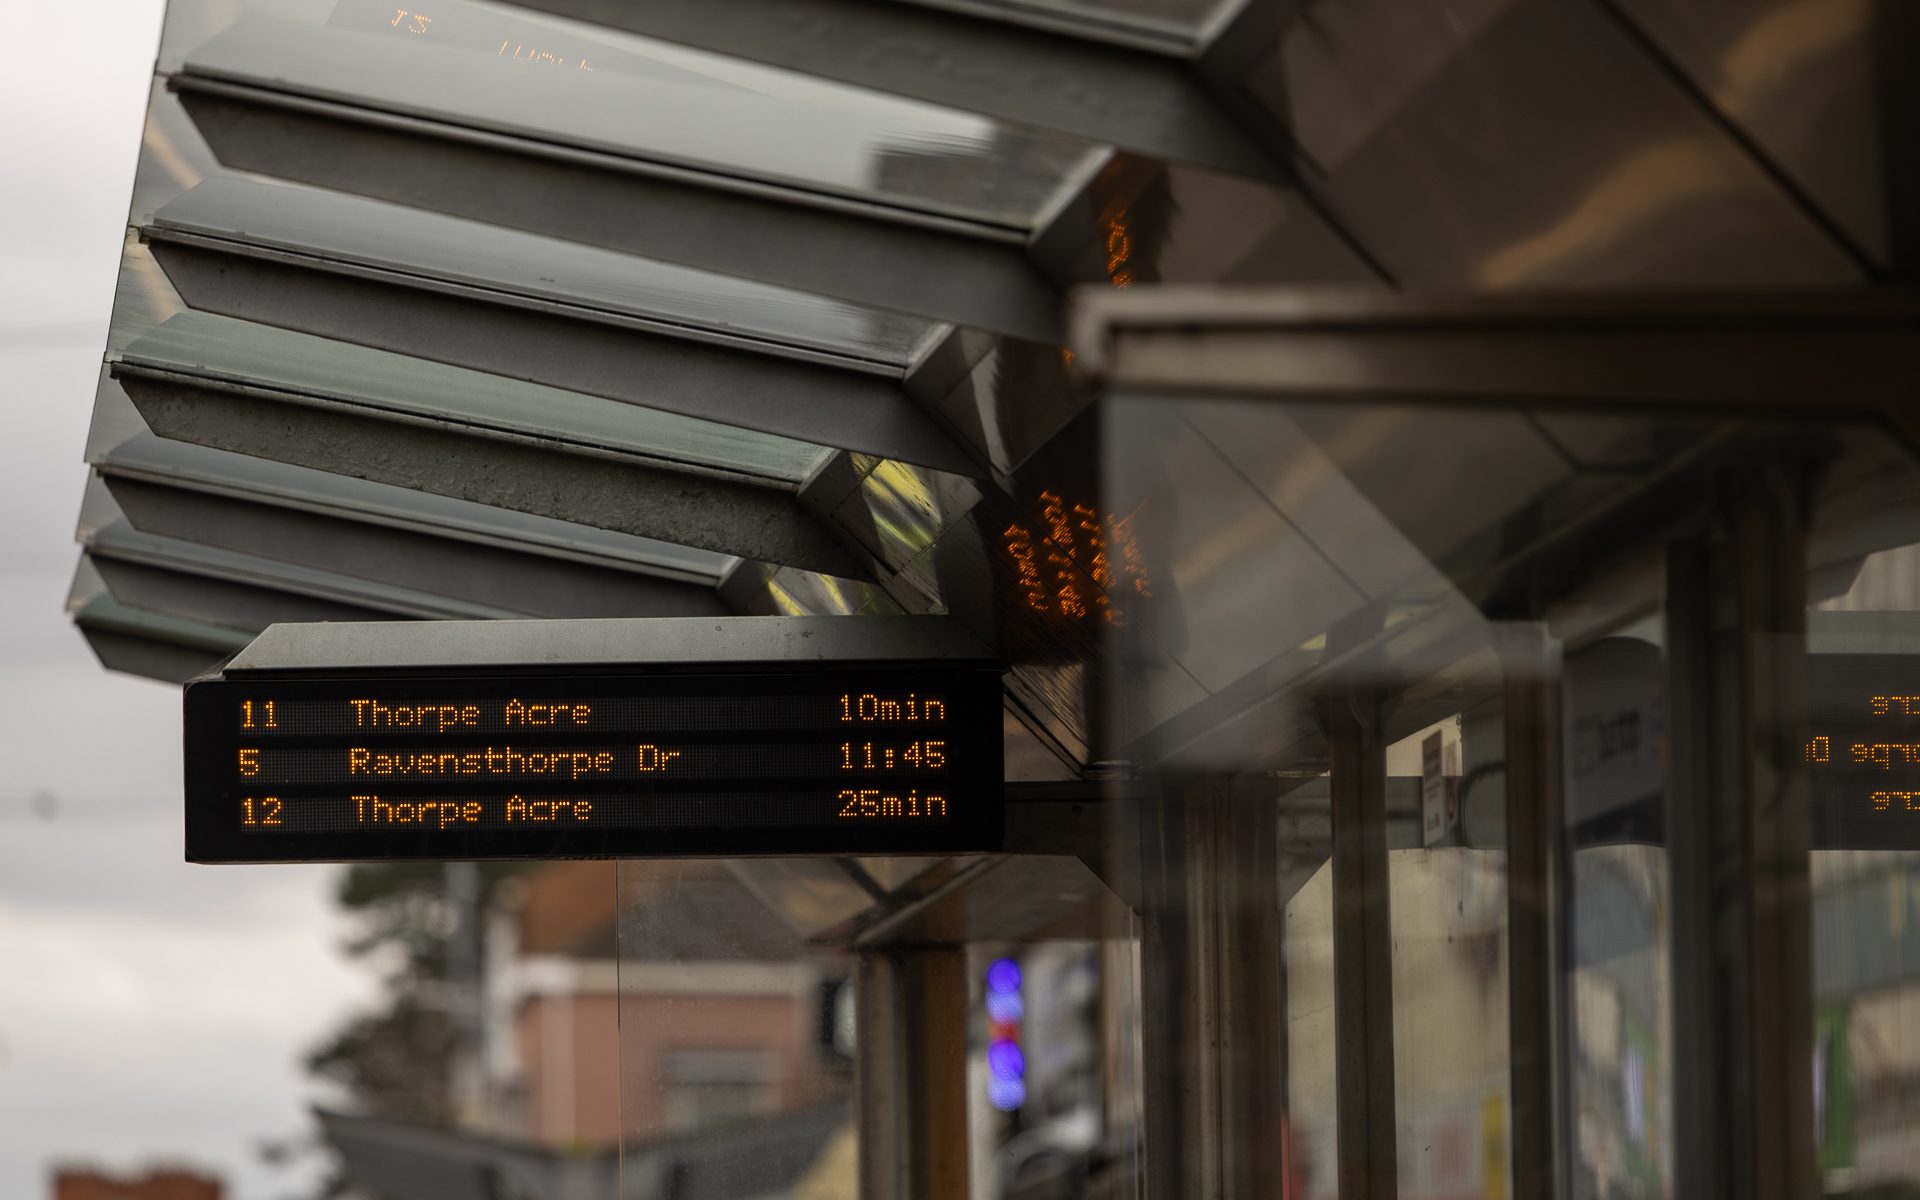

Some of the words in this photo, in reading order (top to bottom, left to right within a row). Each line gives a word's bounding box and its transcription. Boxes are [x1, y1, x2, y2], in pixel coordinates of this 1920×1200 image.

[241, 700, 278, 729] 11
[350, 699, 481, 734] Thorpe
[505, 698, 592, 725] Acre
[839, 692, 945, 722] 10min
[239, 748, 260, 776] 5
[349, 746, 615, 780] Ravensthorpe
[639, 744, 681, 772] Dr
[840, 740, 946, 769] 11:45
[242, 797, 283, 826] 12
[350, 795, 482, 830] Thorpe
[506, 794, 593, 822] Acre
[837, 788, 947, 817] 25min
